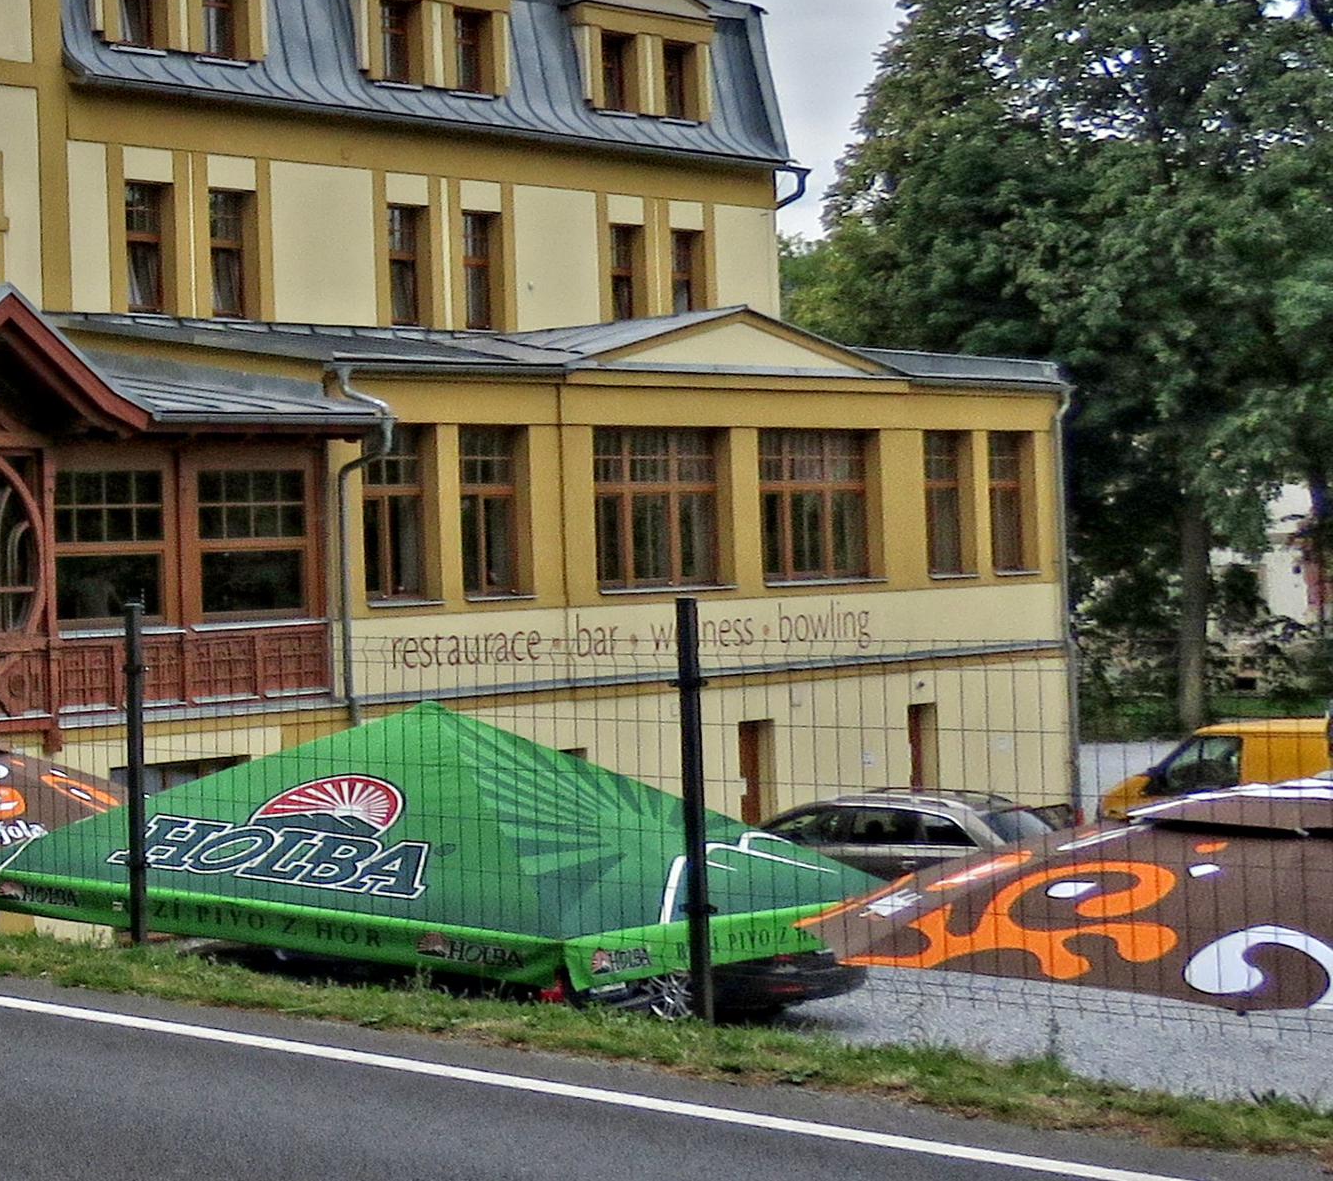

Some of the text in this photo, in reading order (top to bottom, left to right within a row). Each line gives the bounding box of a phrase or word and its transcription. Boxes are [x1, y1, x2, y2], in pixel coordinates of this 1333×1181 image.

[391, 600, 871, 669] restaurace bar wness bowling
[107, 813, 432, 900] HOLBA
[23, 884, 80, 908] HOLBA
[196, 903, 265, 930] PIVO
[282, 917, 300, 936] Z
[728, 928, 770, 952] PIVO
[779, 925, 790, 945] Z
[448, 940, 525, 969] HOLBA
